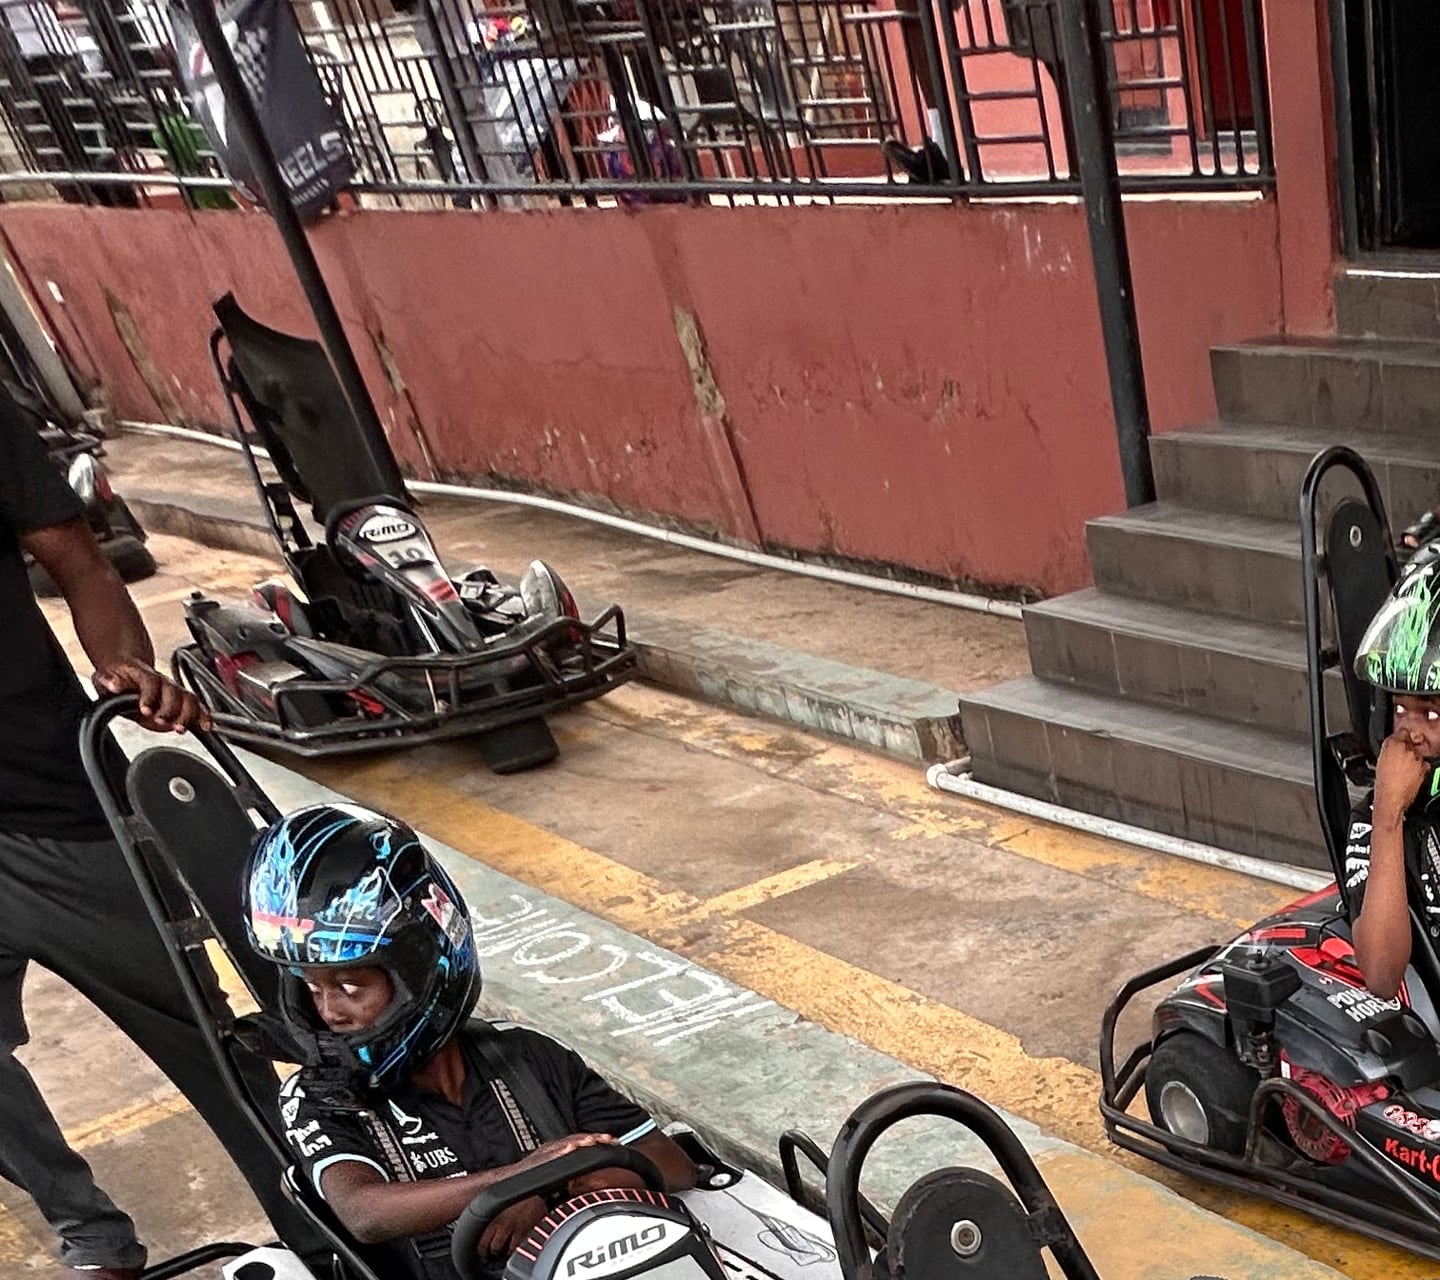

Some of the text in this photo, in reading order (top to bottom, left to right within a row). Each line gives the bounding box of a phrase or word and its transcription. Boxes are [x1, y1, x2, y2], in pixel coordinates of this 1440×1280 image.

[278, 131, 346, 190] EELS
[1326, 987, 1377, 1010] POW
[1345, 994, 1392, 1023] HORS
[423, 1146, 459, 1170] UBS
